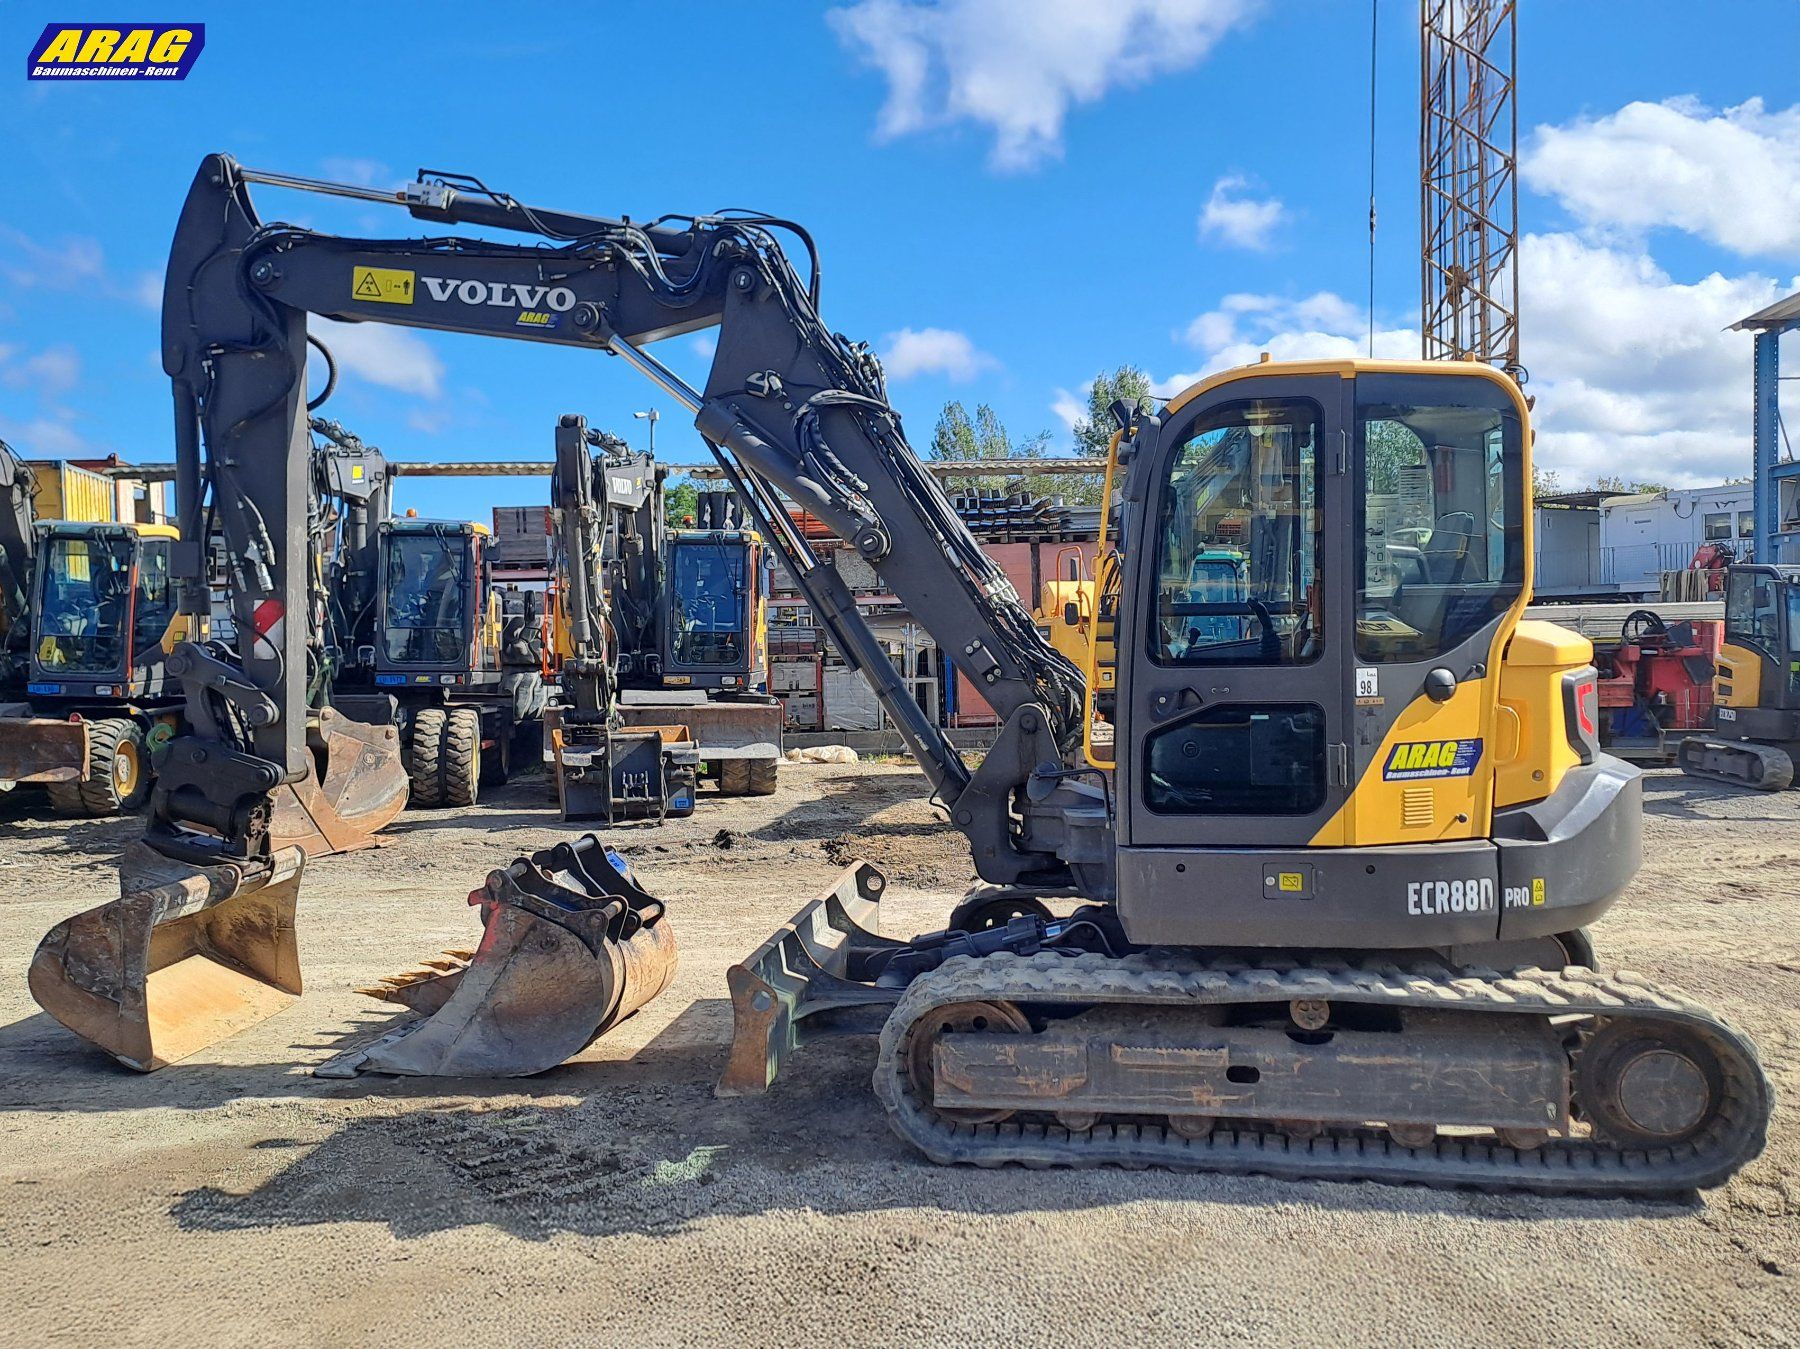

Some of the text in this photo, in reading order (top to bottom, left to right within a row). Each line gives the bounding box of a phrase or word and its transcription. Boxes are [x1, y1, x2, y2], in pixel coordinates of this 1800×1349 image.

[421, 277, 577, 312] VOLVO
[517, 311, 551, 324] ARAG
[1360, 680, 1372, 695] 98
[1388, 741, 1458, 770] ARAG
[1407, 878, 1530, 915] ECR88D PRO
